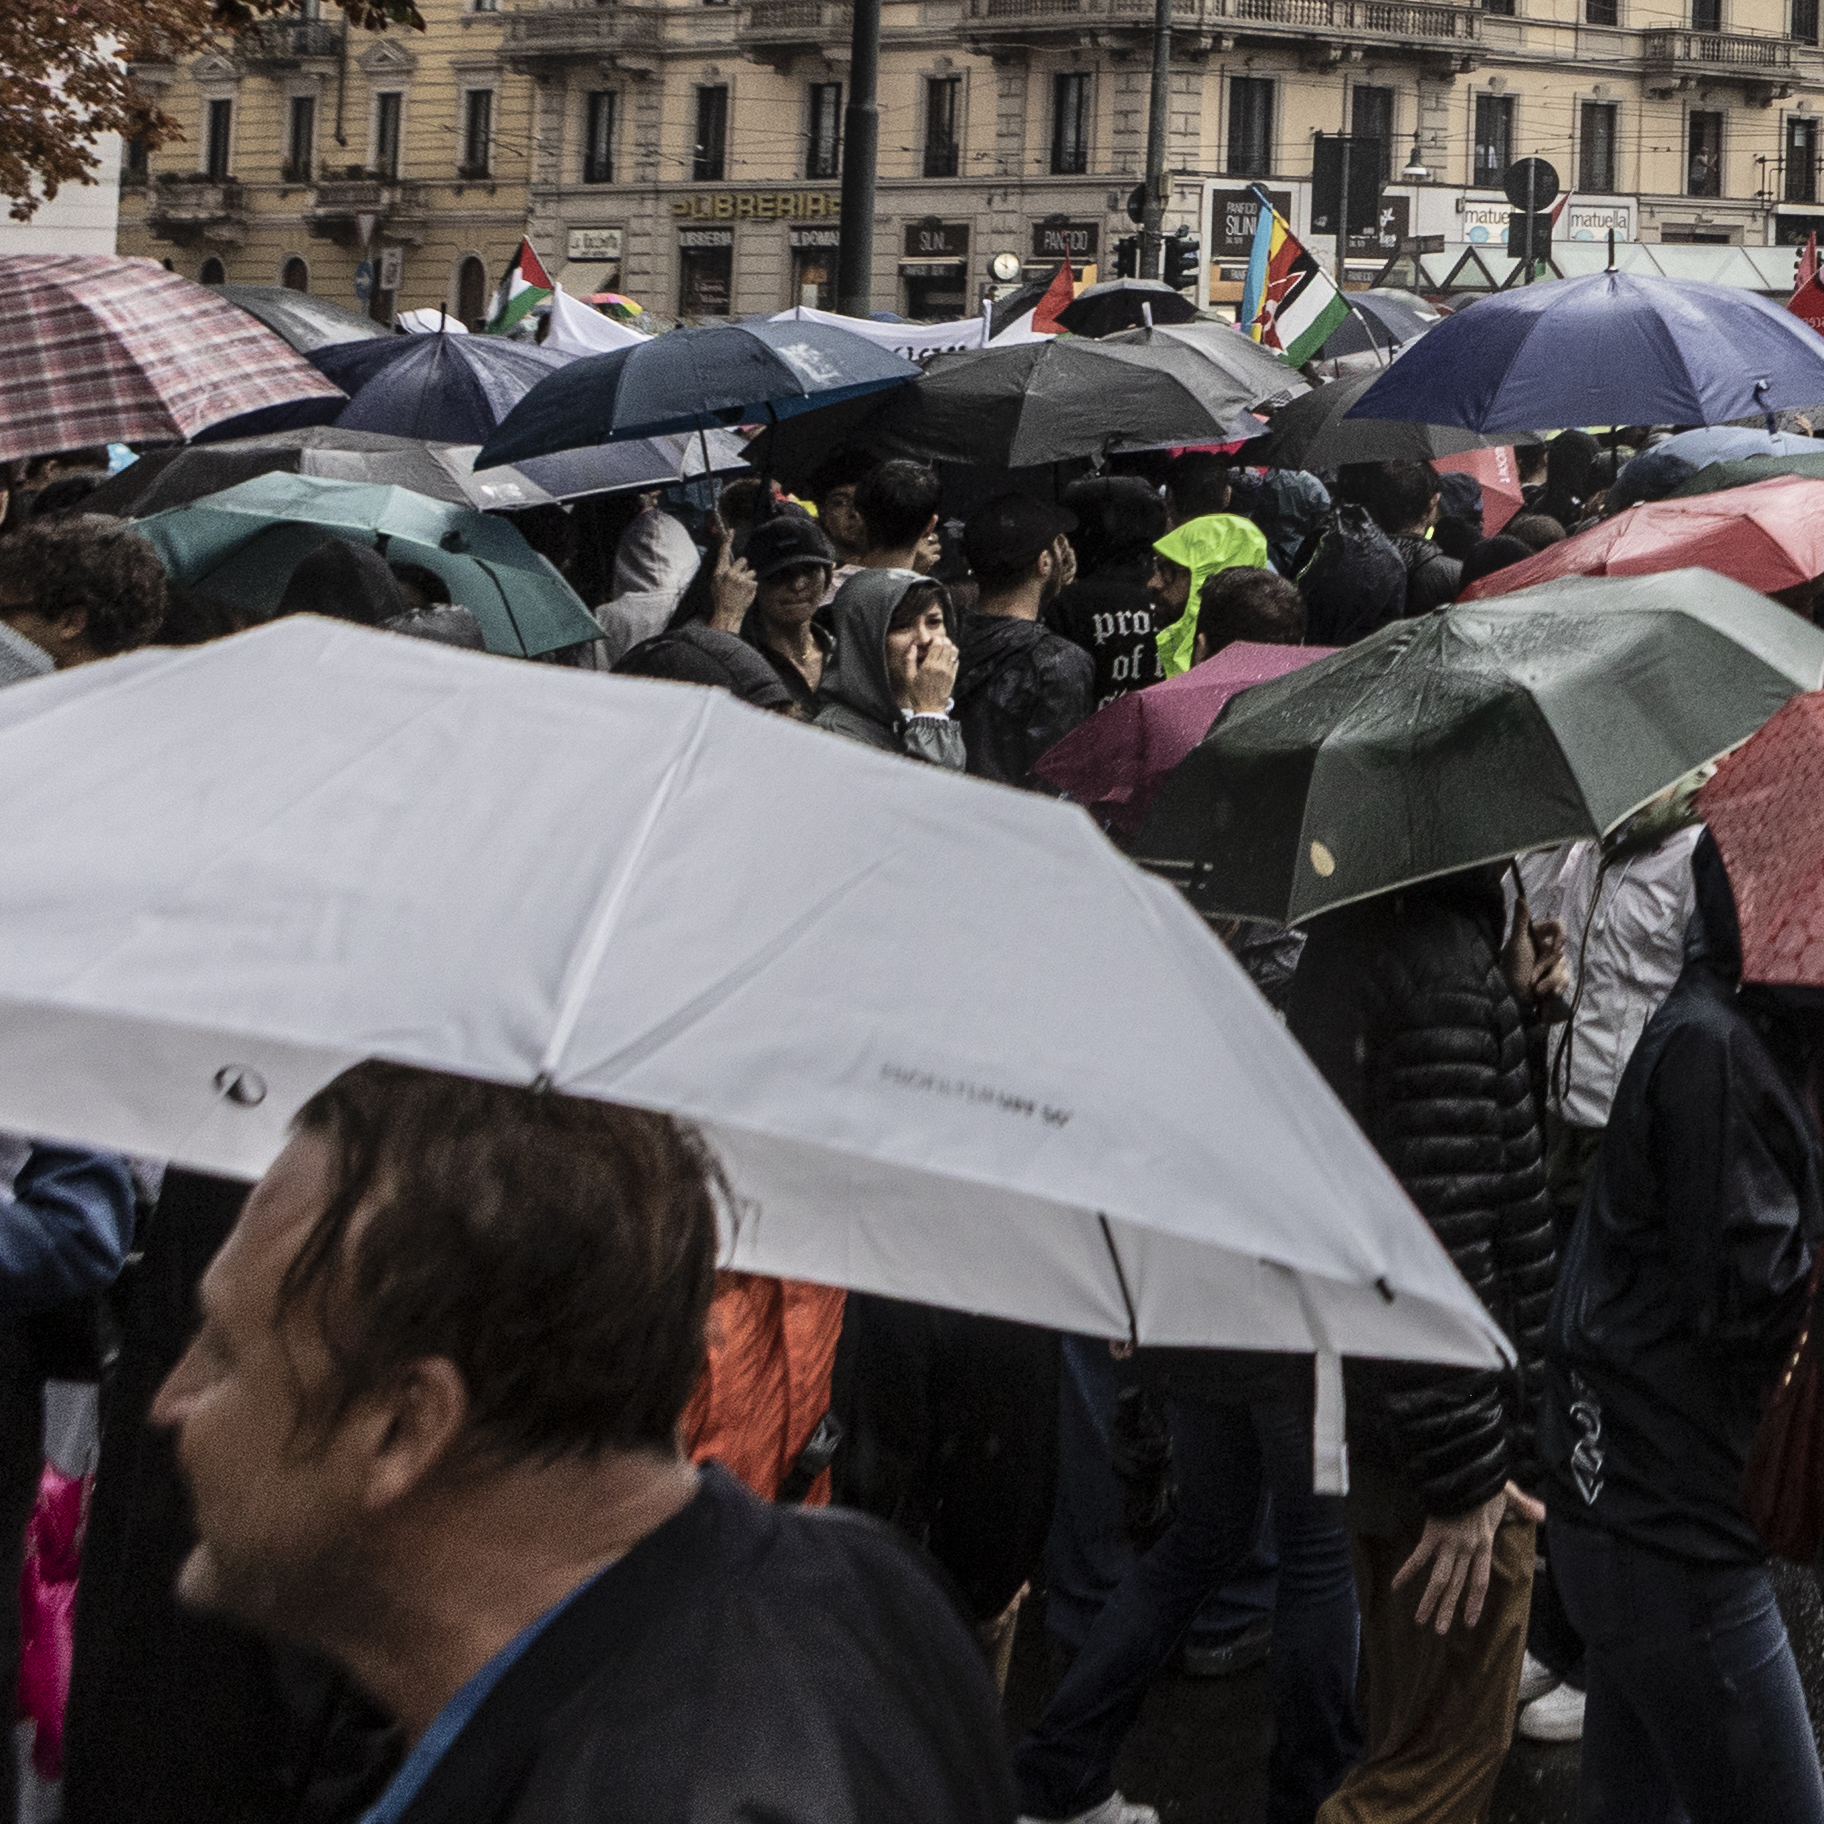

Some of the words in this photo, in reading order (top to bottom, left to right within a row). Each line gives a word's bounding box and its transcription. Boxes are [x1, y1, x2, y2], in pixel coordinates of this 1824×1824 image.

[693, 195, 826, 218] LIBRERIA
[1465, 207, 1510, 224] matue
[1571, 210, 1628, 229] matuella
[1092, 606, 1156, 645] pro
[1112, 644, 1144, 680] of
